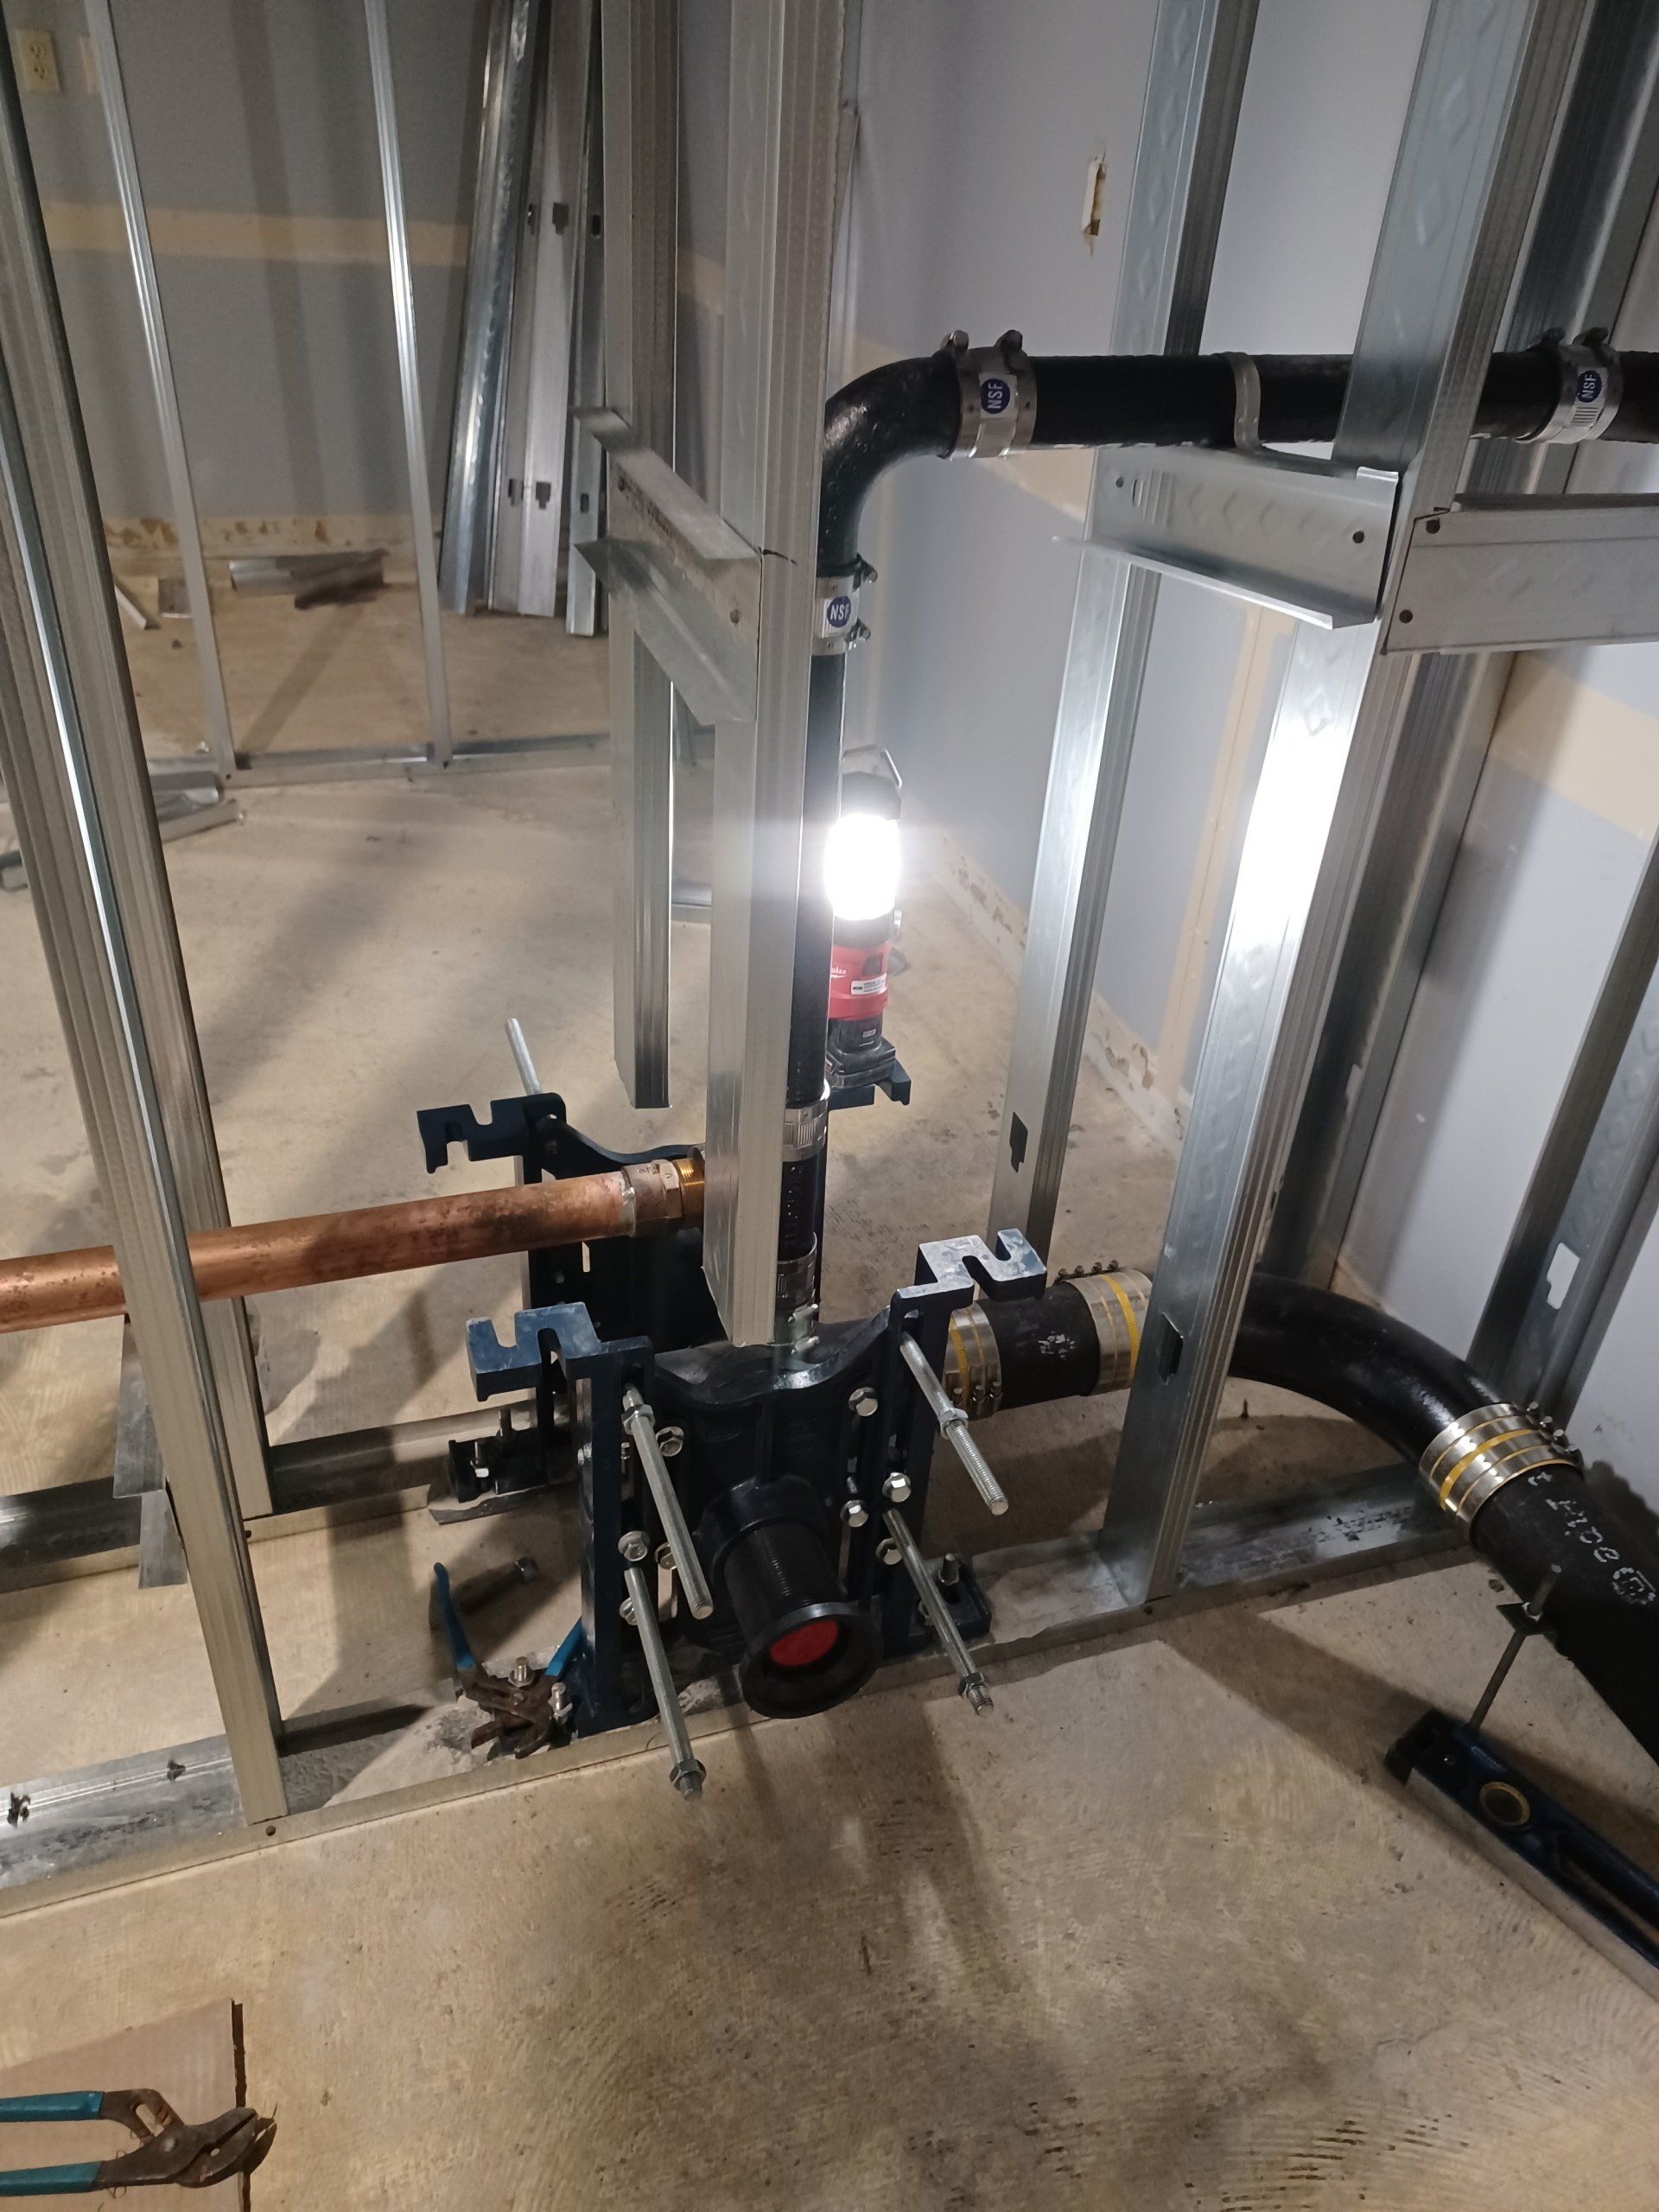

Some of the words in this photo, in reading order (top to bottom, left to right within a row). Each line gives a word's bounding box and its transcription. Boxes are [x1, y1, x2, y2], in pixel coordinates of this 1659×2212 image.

[988, 383, 1002, 409] NSF
[1581, 373, 1596, 398] NSF
[830, 604, 850, 620] NSF
